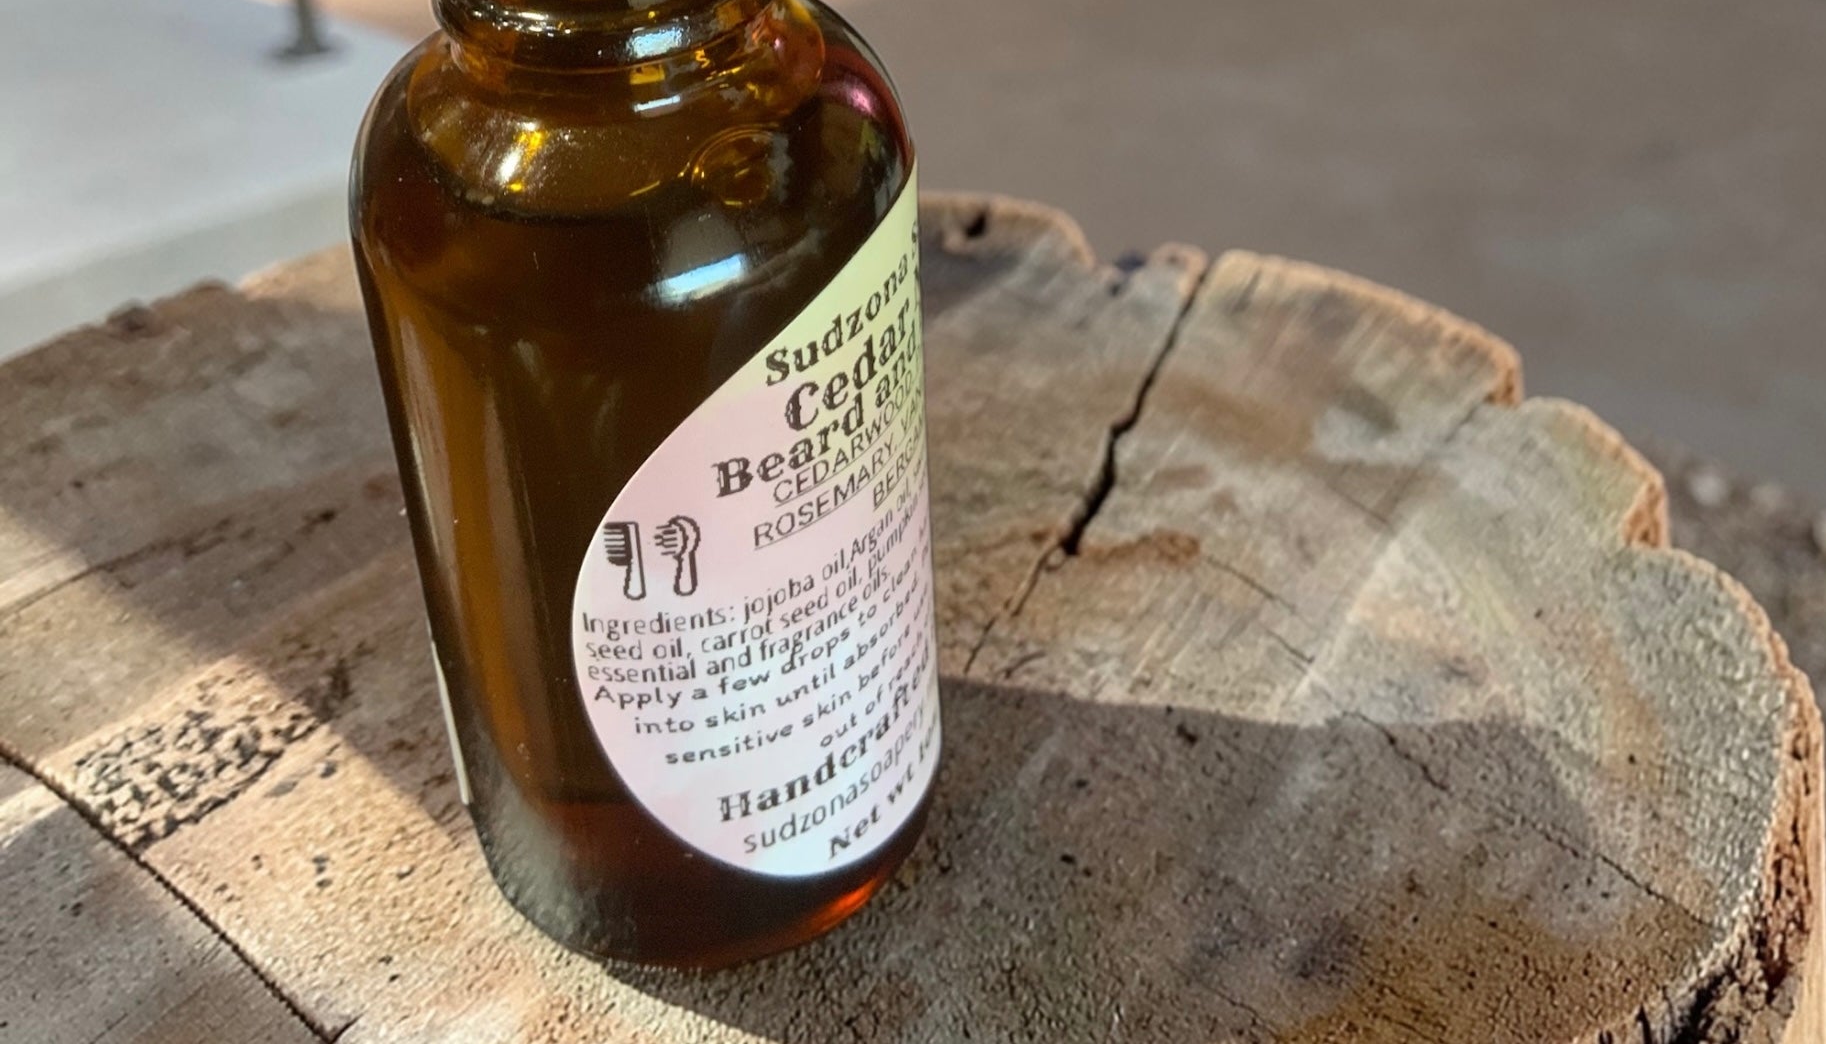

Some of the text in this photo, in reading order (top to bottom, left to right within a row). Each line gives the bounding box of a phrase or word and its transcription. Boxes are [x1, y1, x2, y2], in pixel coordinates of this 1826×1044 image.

[764, 253, 908, 387] Sudzona
[784, 297, 910, 431] Cedar
[711, 319, 916, 498] Beard and
[583, 607, 735, 640] Ingredients:
[743, 575, 814, 624] jojoba
[586, 640, 643, 661] seed
[701, 619, 773, 654] carrot
[780, 586, 829, 630] seed
[588, 660, 696, 684] essential
[706, 651, 751, 678] and
[760, 596, 858, 662] fragrance
[593, 686, 682, 711] Apply
[691, 687, 708, 702] a
[718, 668, 770, 697] few
[781, 628, 851, 675] drops
[857, 605, 877, 627] to
[635, 716, 695, 735] into
[706, 701, 766, 729] skin
[775, 662, 836, 709] until
[665, 723, 794, 765] sensitive
[802, 691, 852, 729] skin
[717, 638, 929, 823] Handcrafted
[820, 712, 858, 748] out
[865, 683, 883, 716] of
[828, 803, 882, 860] Net
